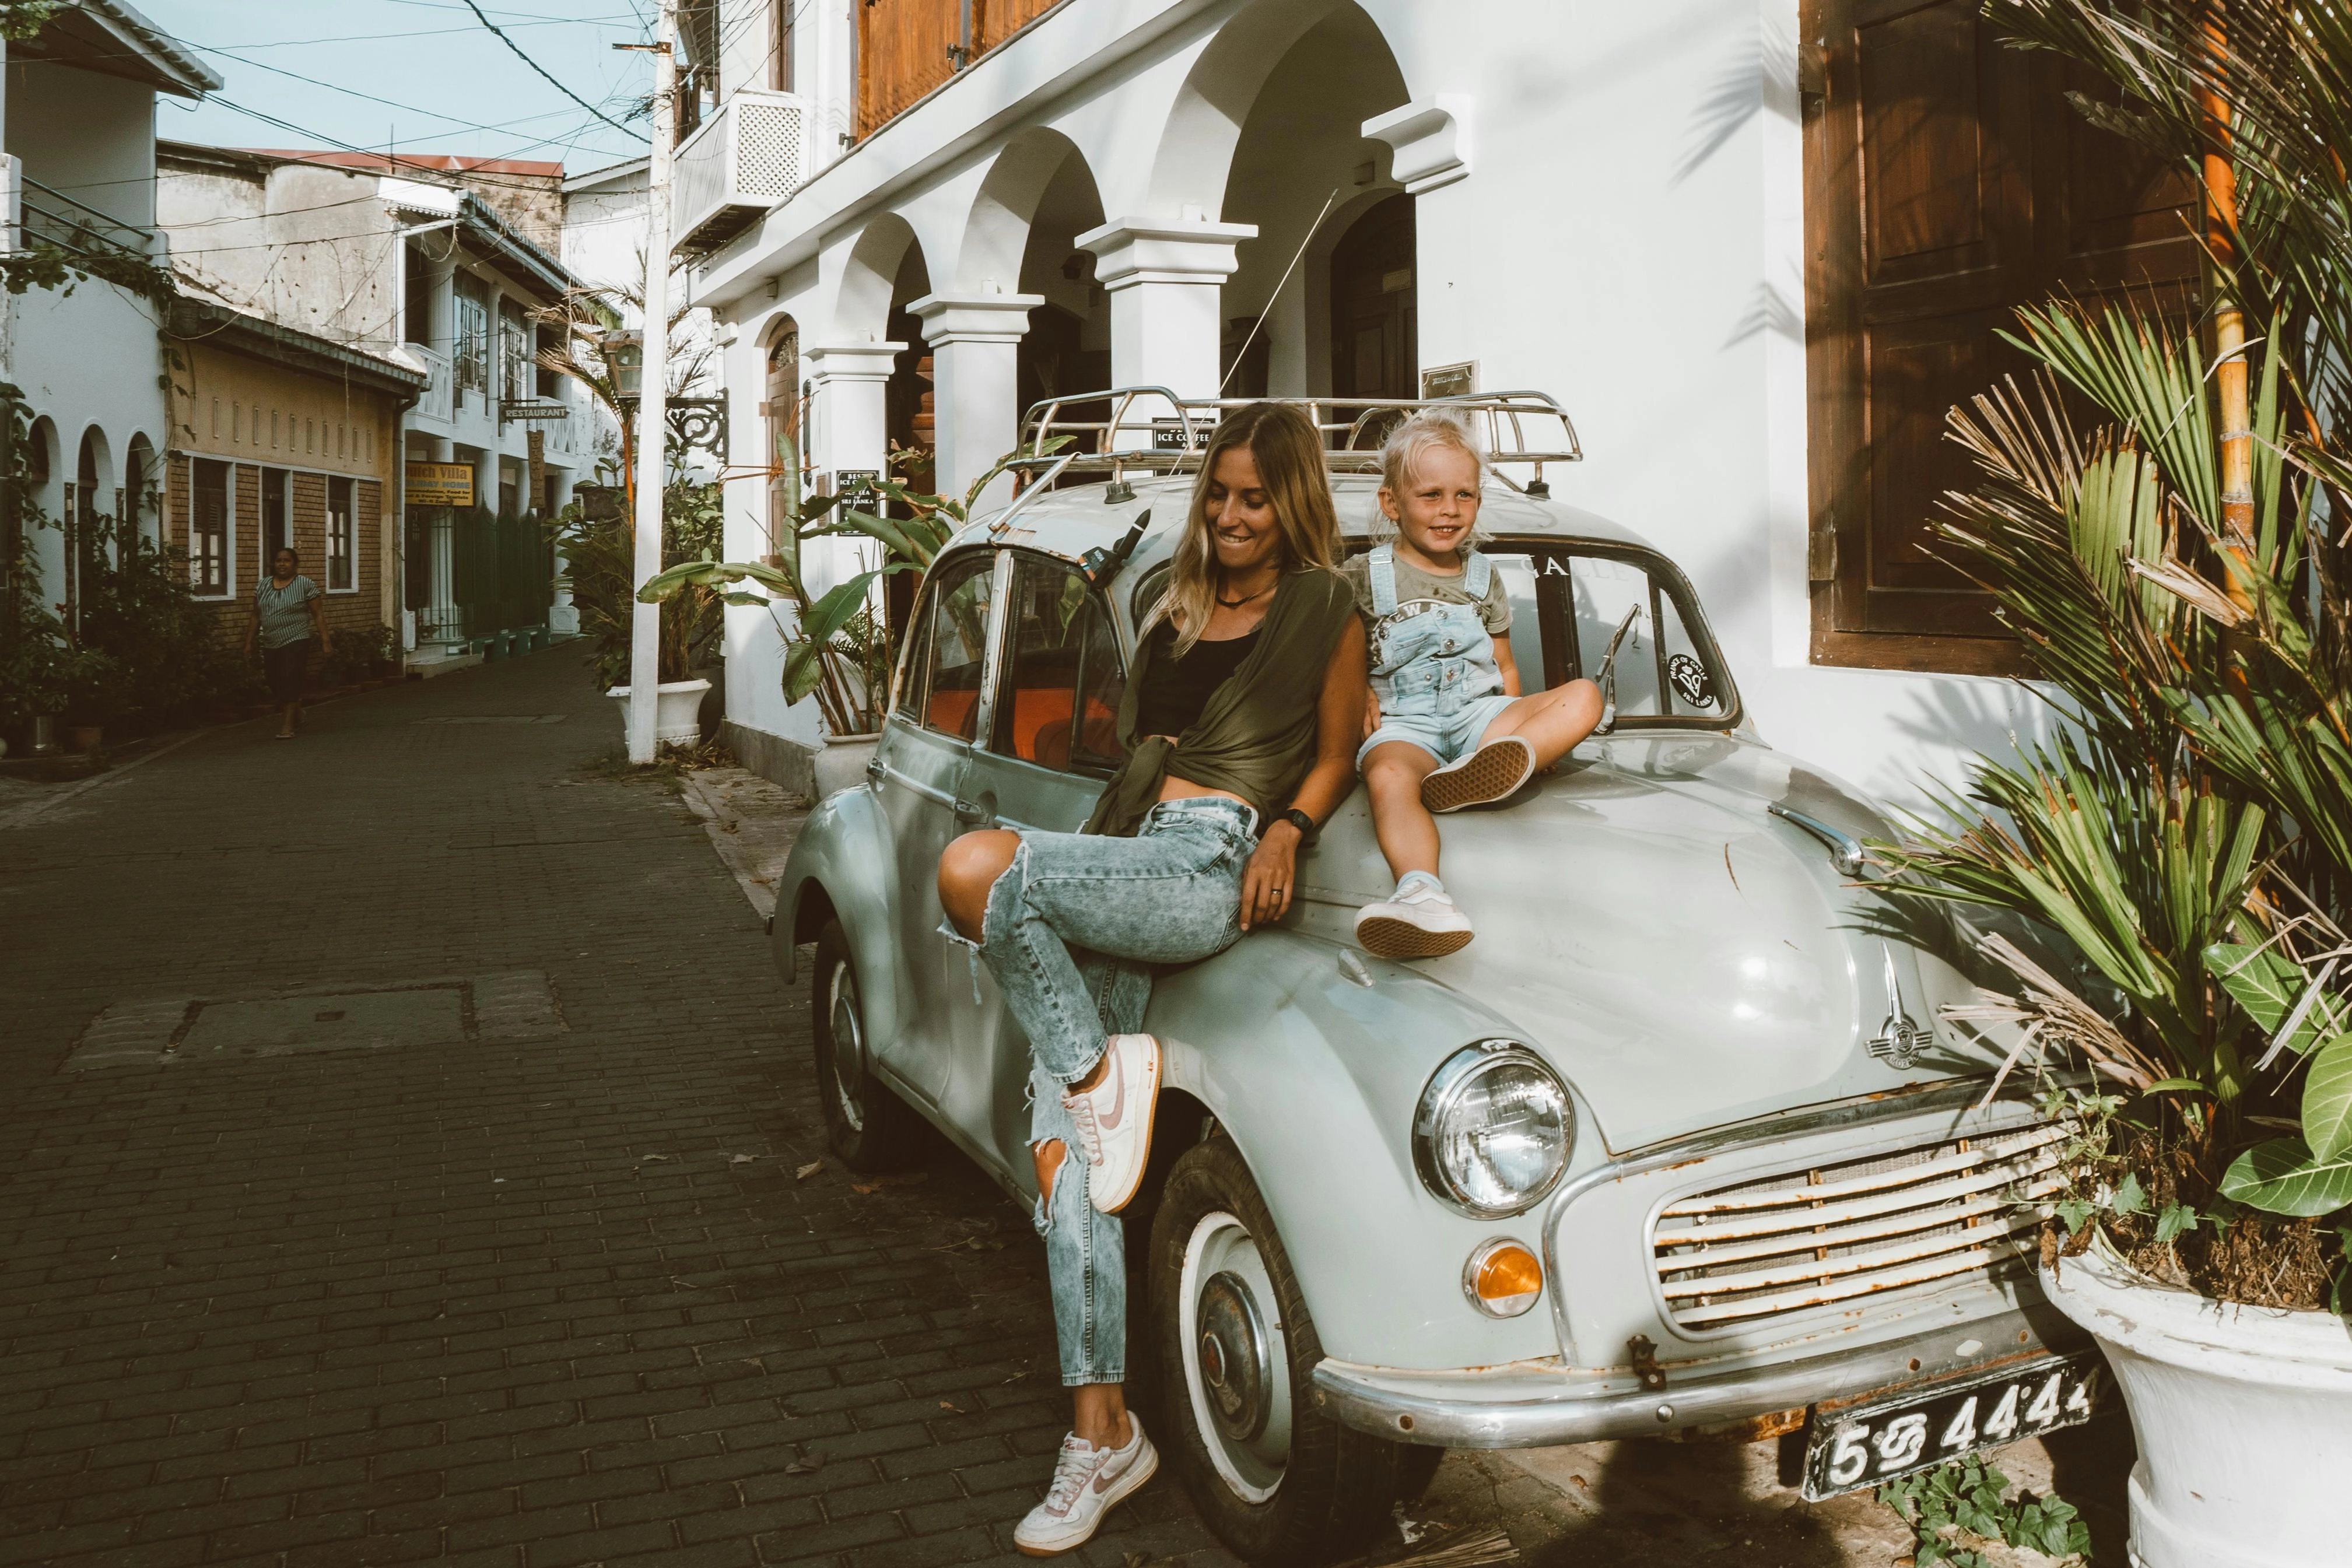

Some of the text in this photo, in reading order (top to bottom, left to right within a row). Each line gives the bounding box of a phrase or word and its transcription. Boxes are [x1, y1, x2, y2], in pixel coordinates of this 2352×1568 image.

[506, 409, 566, 417] RESTAURANT
[440, 466, 467, 479] Villa
[1682, 692, 1694, 703] SRI
[1829, 1425, 1870, 1486] 5
[1940, 1363, 2099, 1451] 4444
